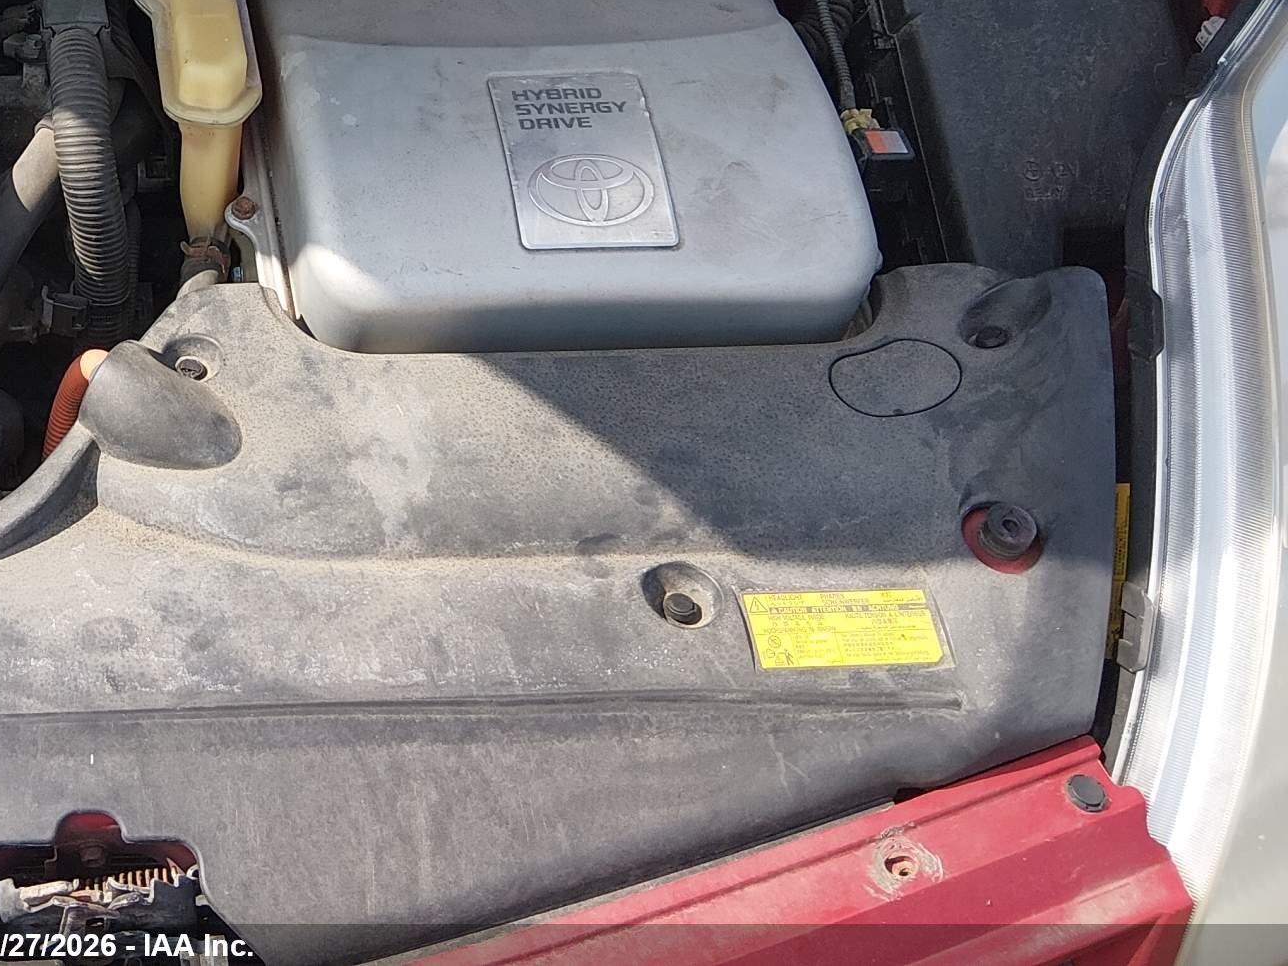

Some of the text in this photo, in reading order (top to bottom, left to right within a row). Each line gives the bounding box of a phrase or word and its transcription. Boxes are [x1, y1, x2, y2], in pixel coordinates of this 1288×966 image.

[511, 87, 602, 101] HYBRID
[515, 101, 627, 116] SYNERGY
[519, 117, 592, 130] DRIVE
